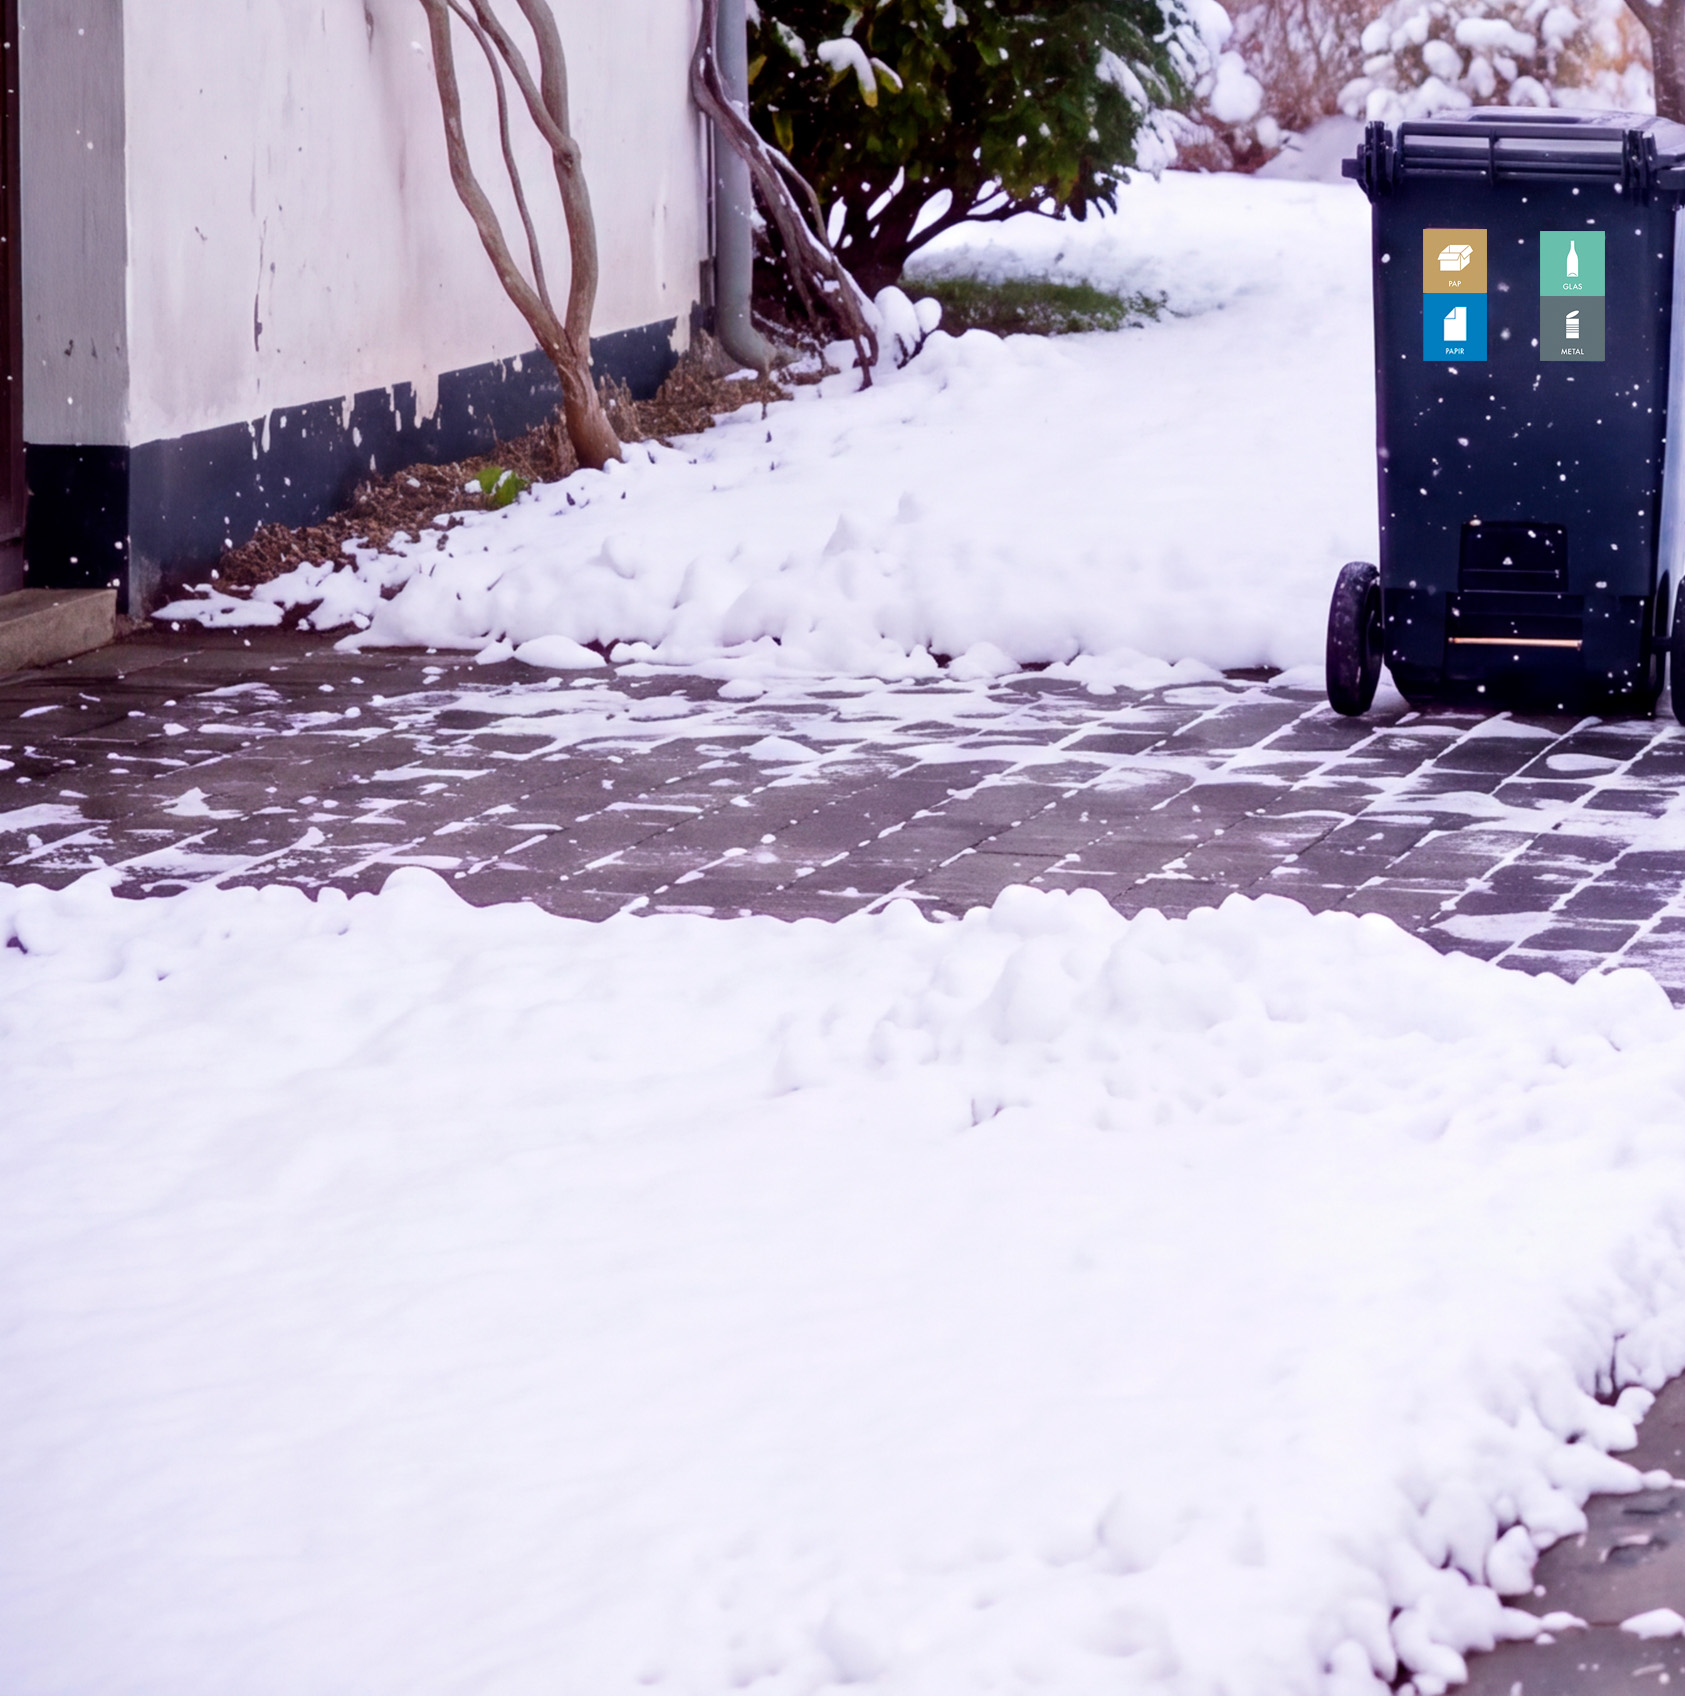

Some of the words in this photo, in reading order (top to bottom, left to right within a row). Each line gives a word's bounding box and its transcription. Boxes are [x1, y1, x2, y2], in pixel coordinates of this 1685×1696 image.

[1448, 280, 1462, 288] PAP
[1562, 283, 1583, 291] GLAS
[1445, 347, 1465, 355] PAPIR
[1560, 347, 1585, 355] METAL
